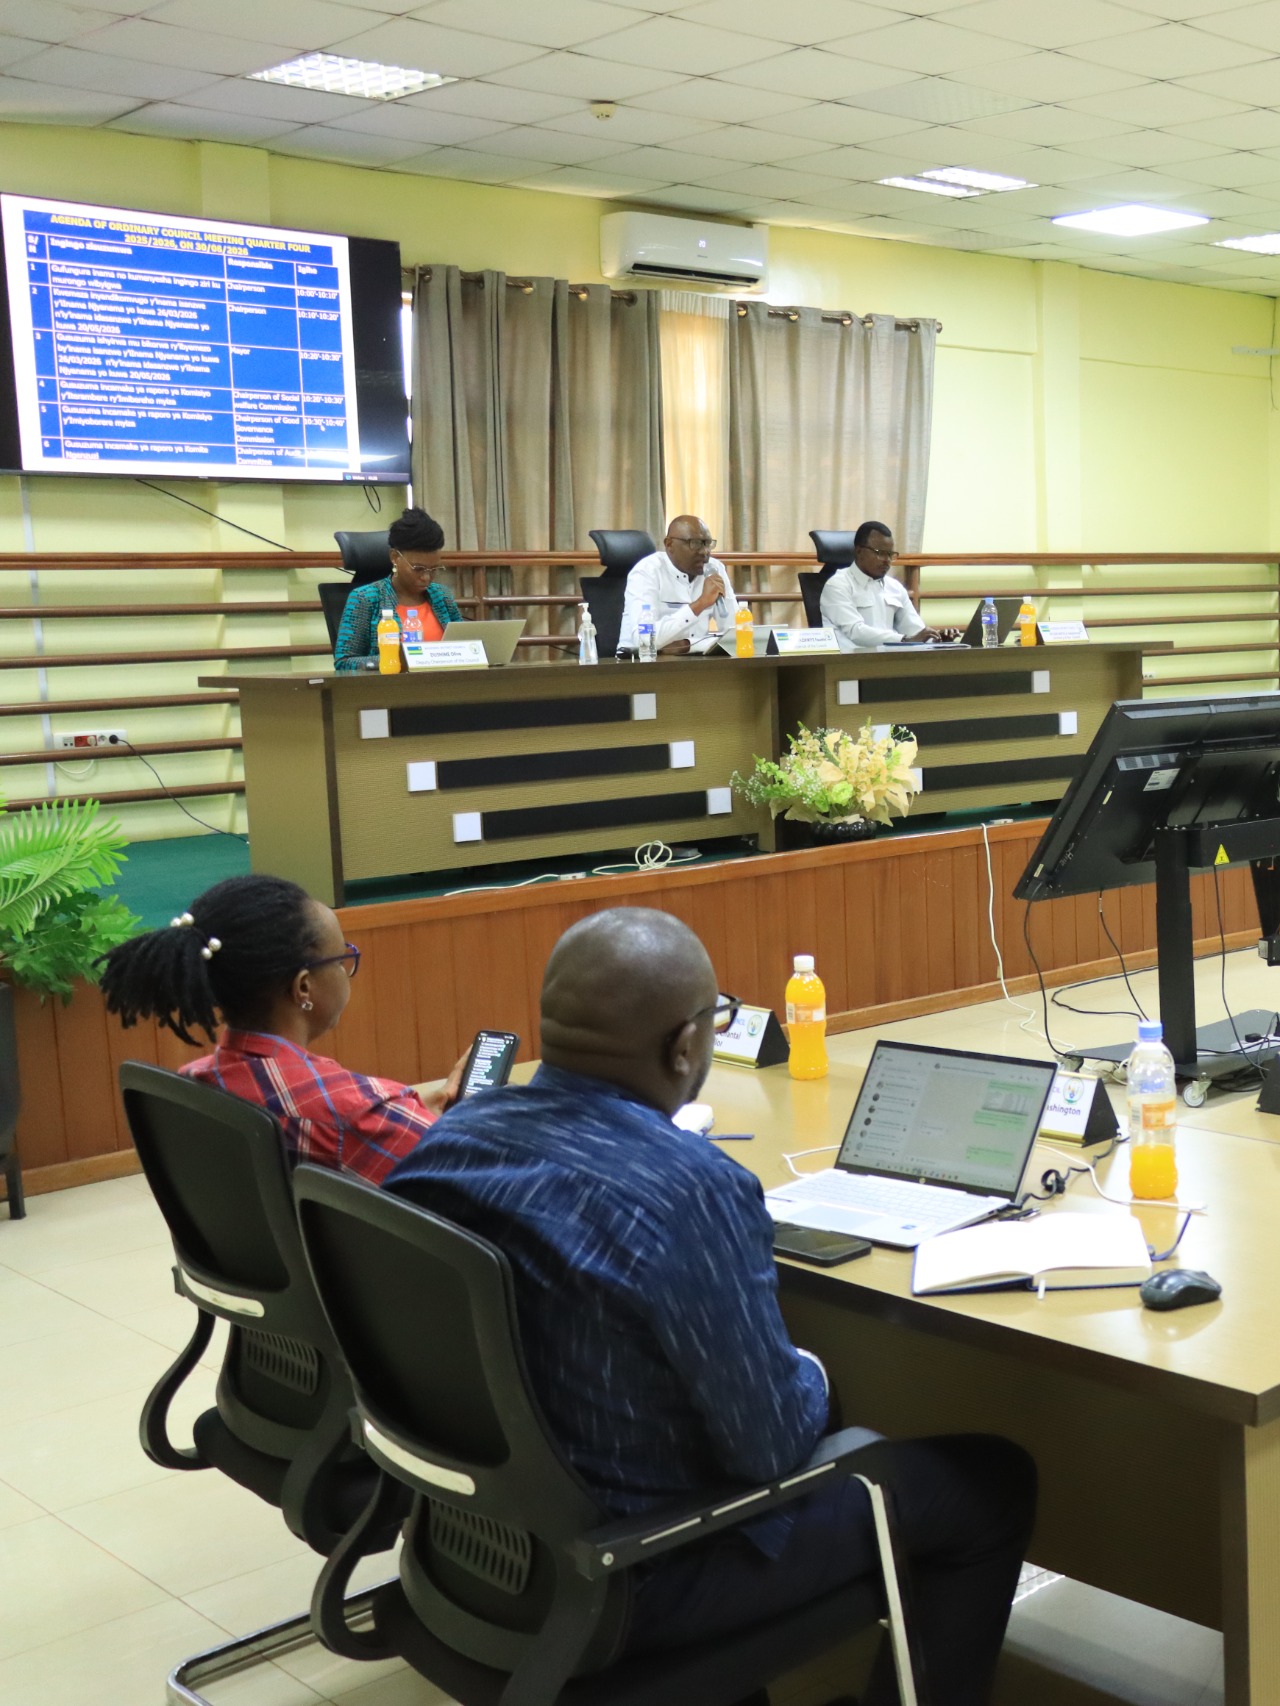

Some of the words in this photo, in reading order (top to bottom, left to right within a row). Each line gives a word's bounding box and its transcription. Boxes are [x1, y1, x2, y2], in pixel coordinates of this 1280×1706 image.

[50, 215, 91, 227] AGENDA
[93, 219, 106, 229] OF
[108, 221, 159, 235] ORDINARY
[161, 227, 201, 240] COUNCIL
[204, 232, 244, 245] MEETING
[246, 237, 286, 249] QUARTER
[288, 242, 310, 252] FOUR
[179, 240, 193, 250] ON
[228, 258, 273, 270] Responsible
